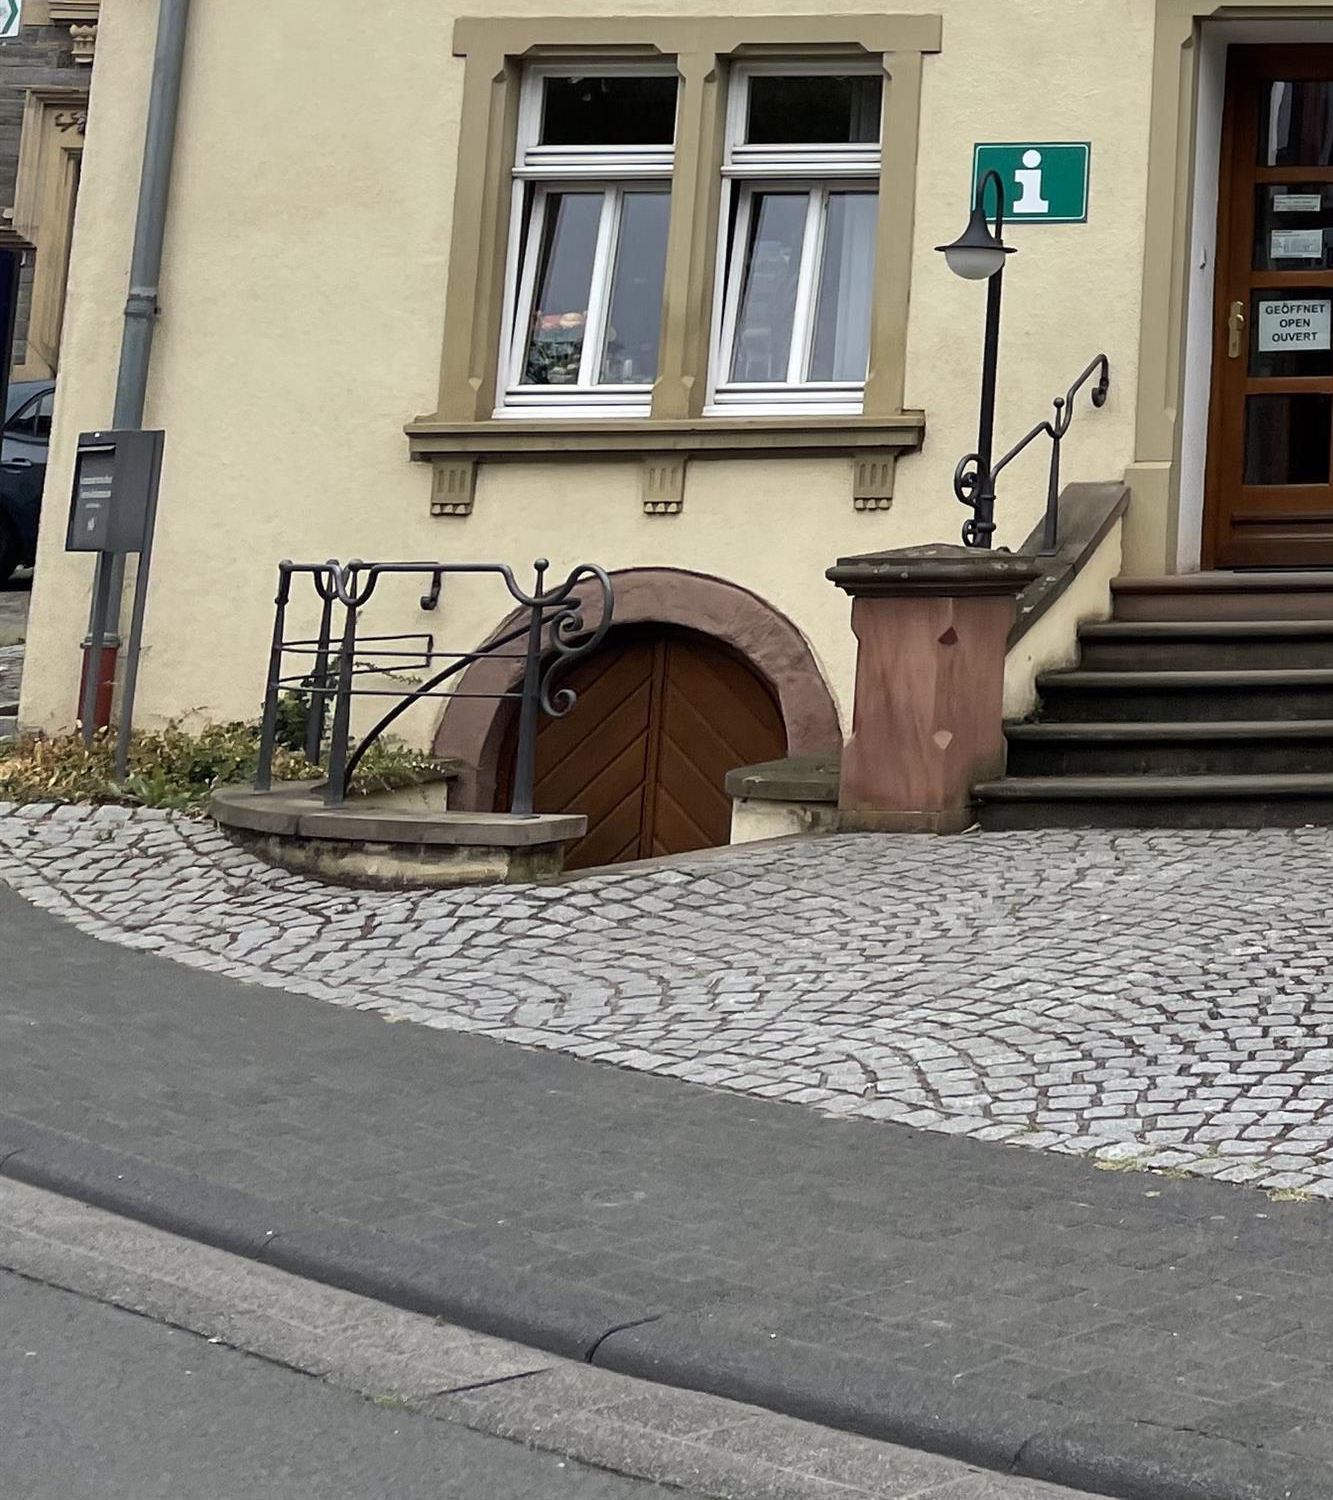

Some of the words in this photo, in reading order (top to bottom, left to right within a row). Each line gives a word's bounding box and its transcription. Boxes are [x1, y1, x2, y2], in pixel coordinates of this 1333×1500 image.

[1265, 303, 1326, 315] GEÖFFNET
[1279, 318, 1310, 328] OPEN
[1271, 331, 1318, 342] OUVERT
